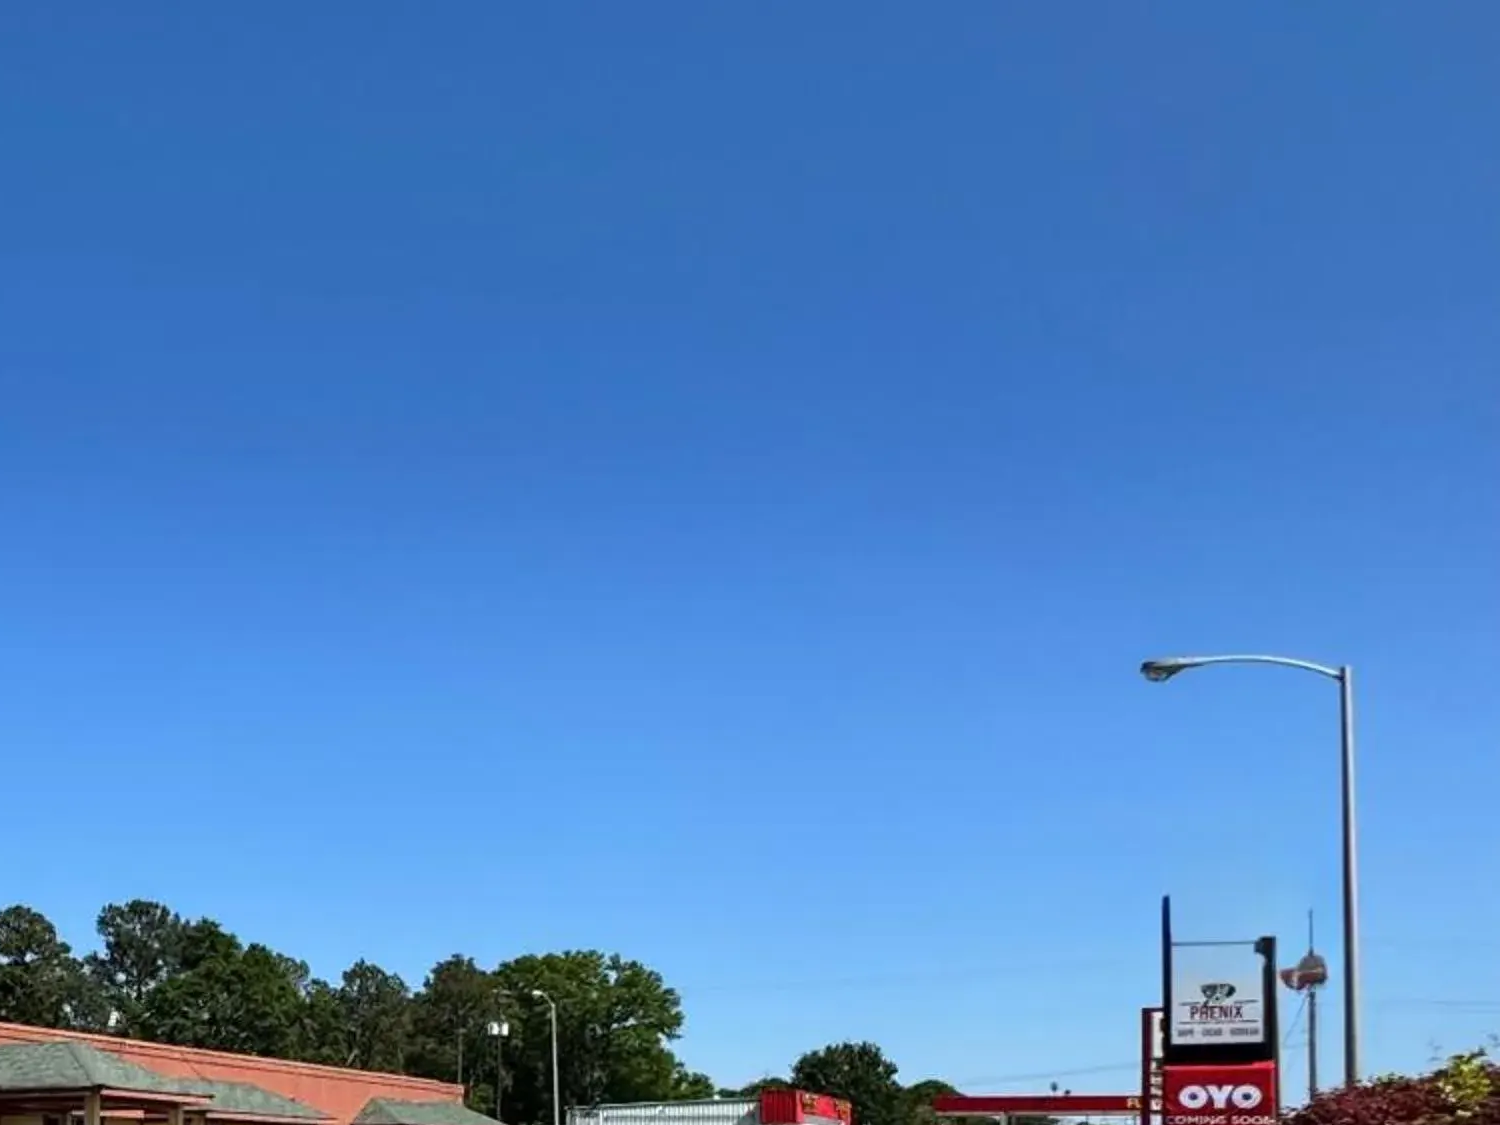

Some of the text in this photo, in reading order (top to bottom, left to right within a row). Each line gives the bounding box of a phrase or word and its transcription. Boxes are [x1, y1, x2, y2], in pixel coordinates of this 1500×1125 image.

[1190, 1005, 1243, 1020] PHENIX
[1178, 1084, 1263, 1110] OYO
[1165, 1115, 1228, 1125] COMING
